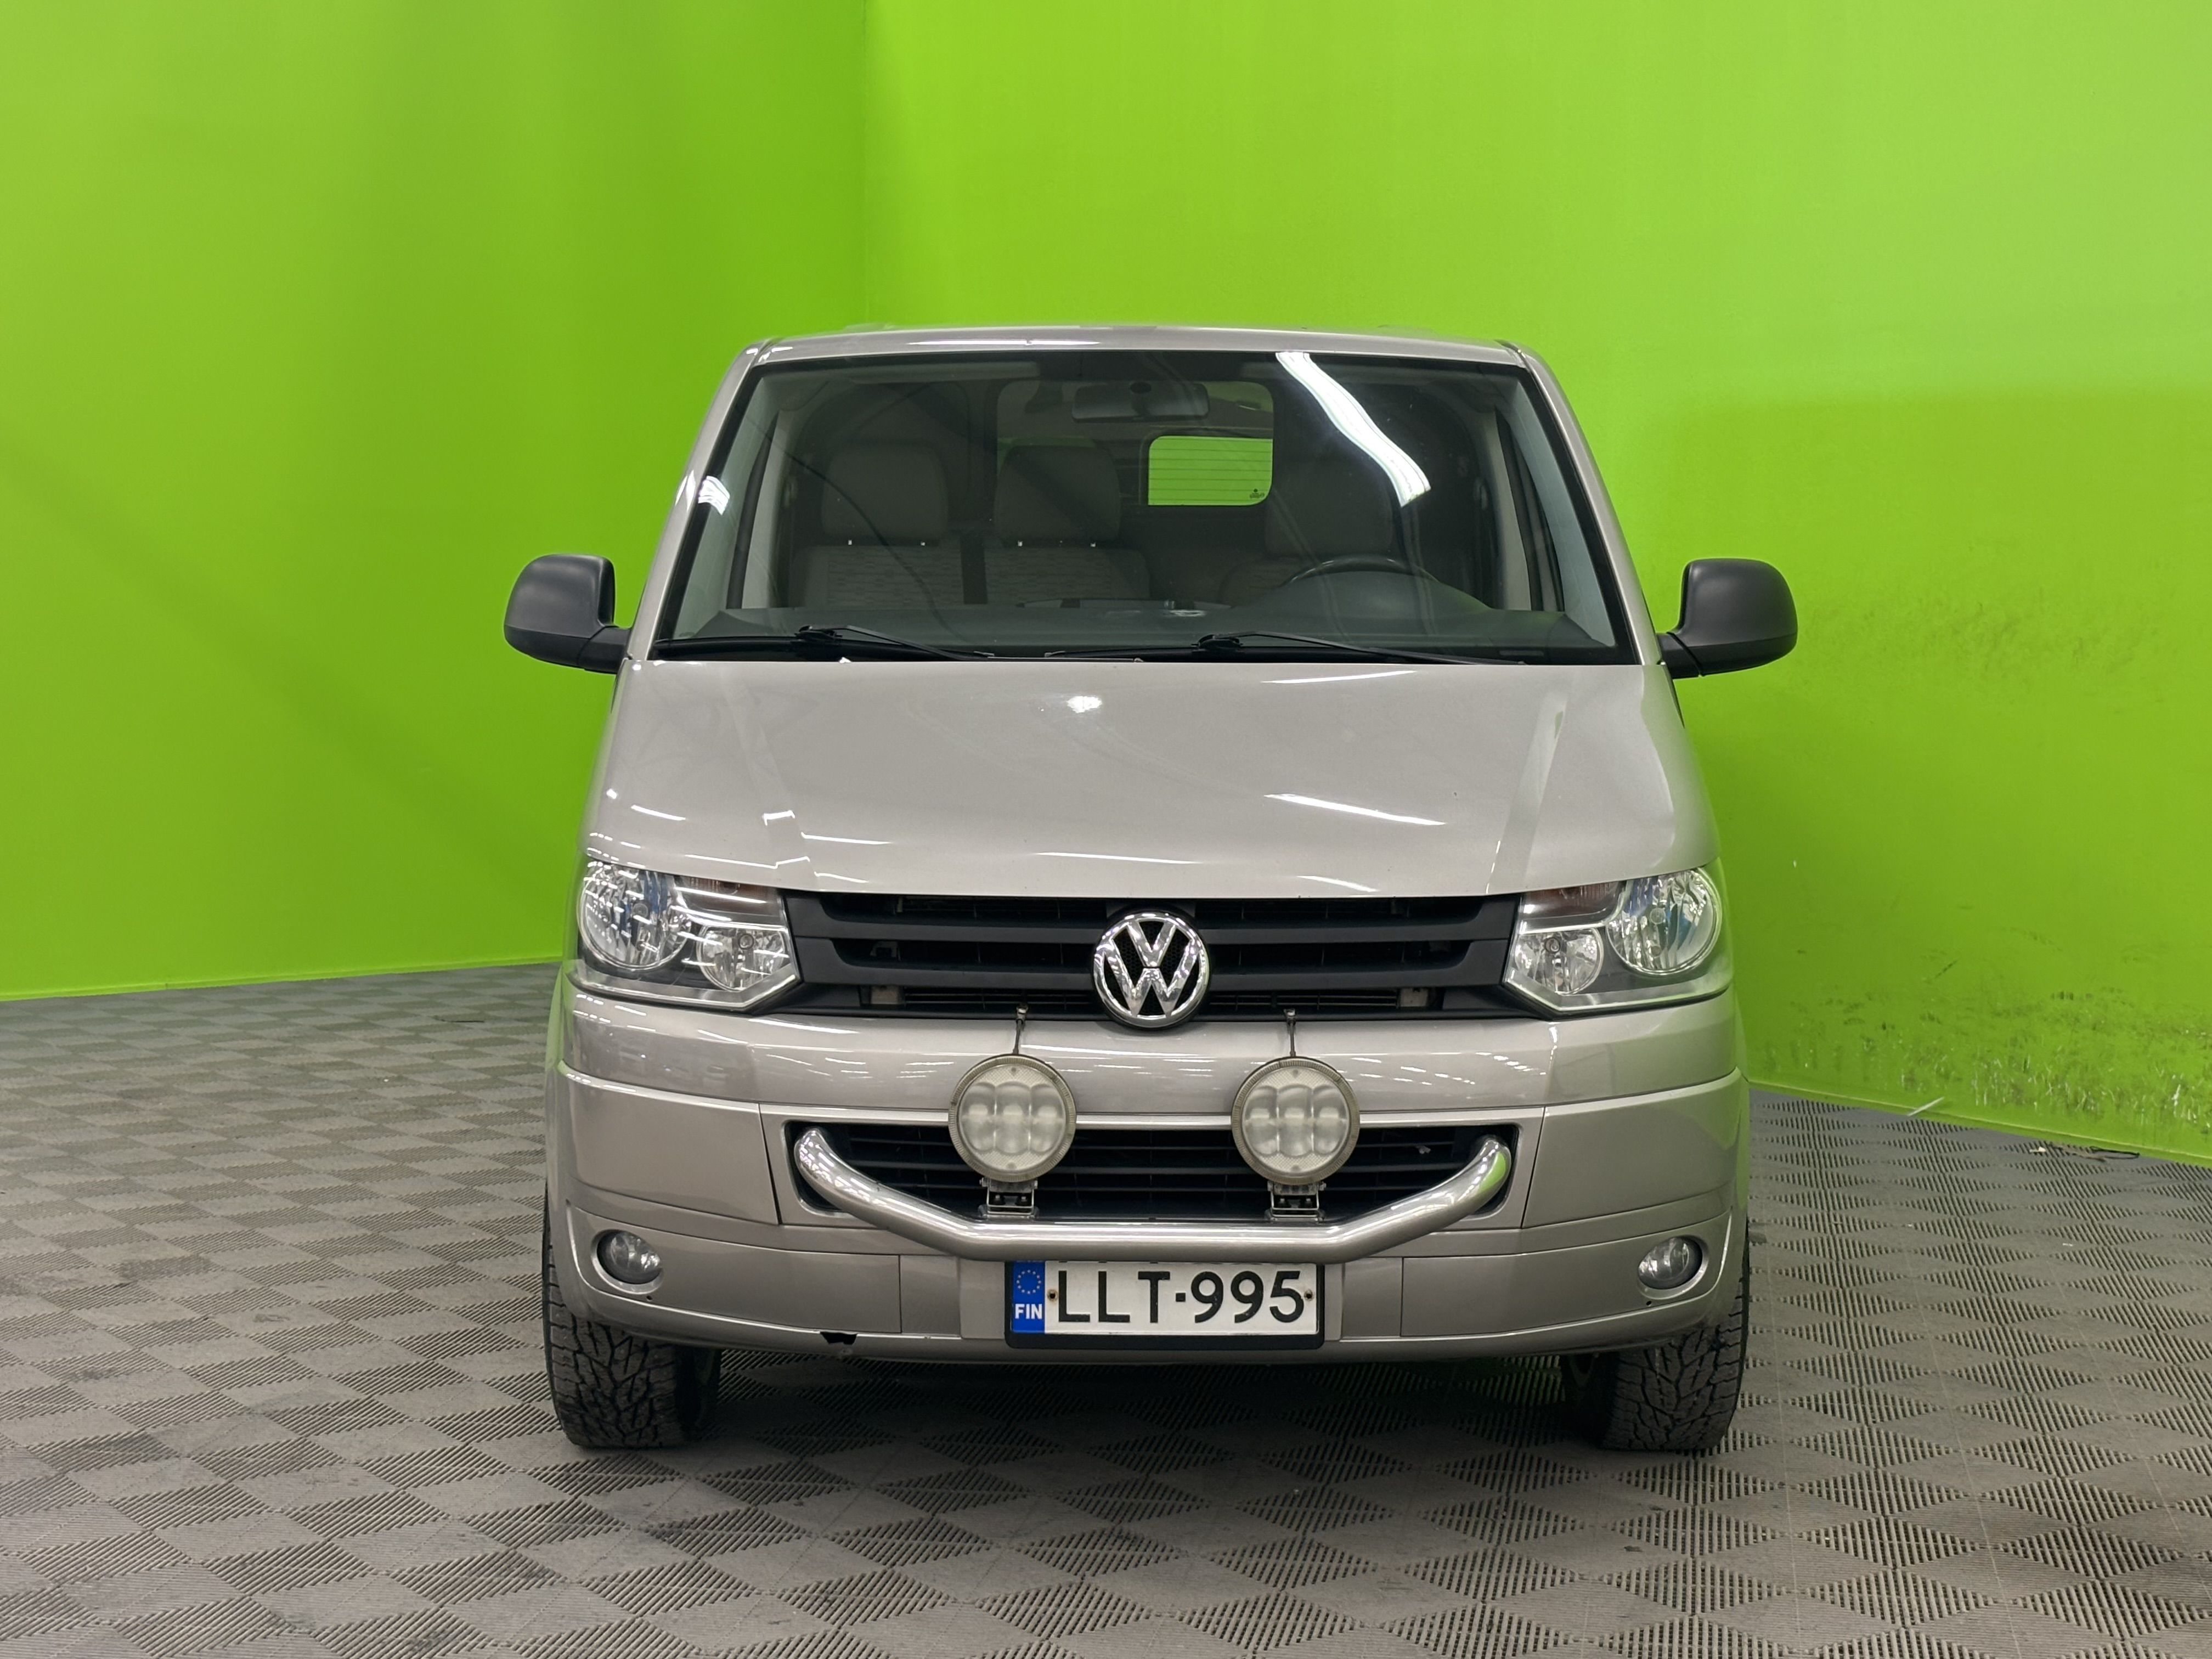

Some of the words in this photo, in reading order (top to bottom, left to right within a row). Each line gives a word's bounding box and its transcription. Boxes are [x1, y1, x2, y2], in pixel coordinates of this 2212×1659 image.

[1098, 918, 1204, 1019] VW
[1015, 1304, 1042, 1319] FIN
[1058, 1270, 1305, 1323] LLT-995
